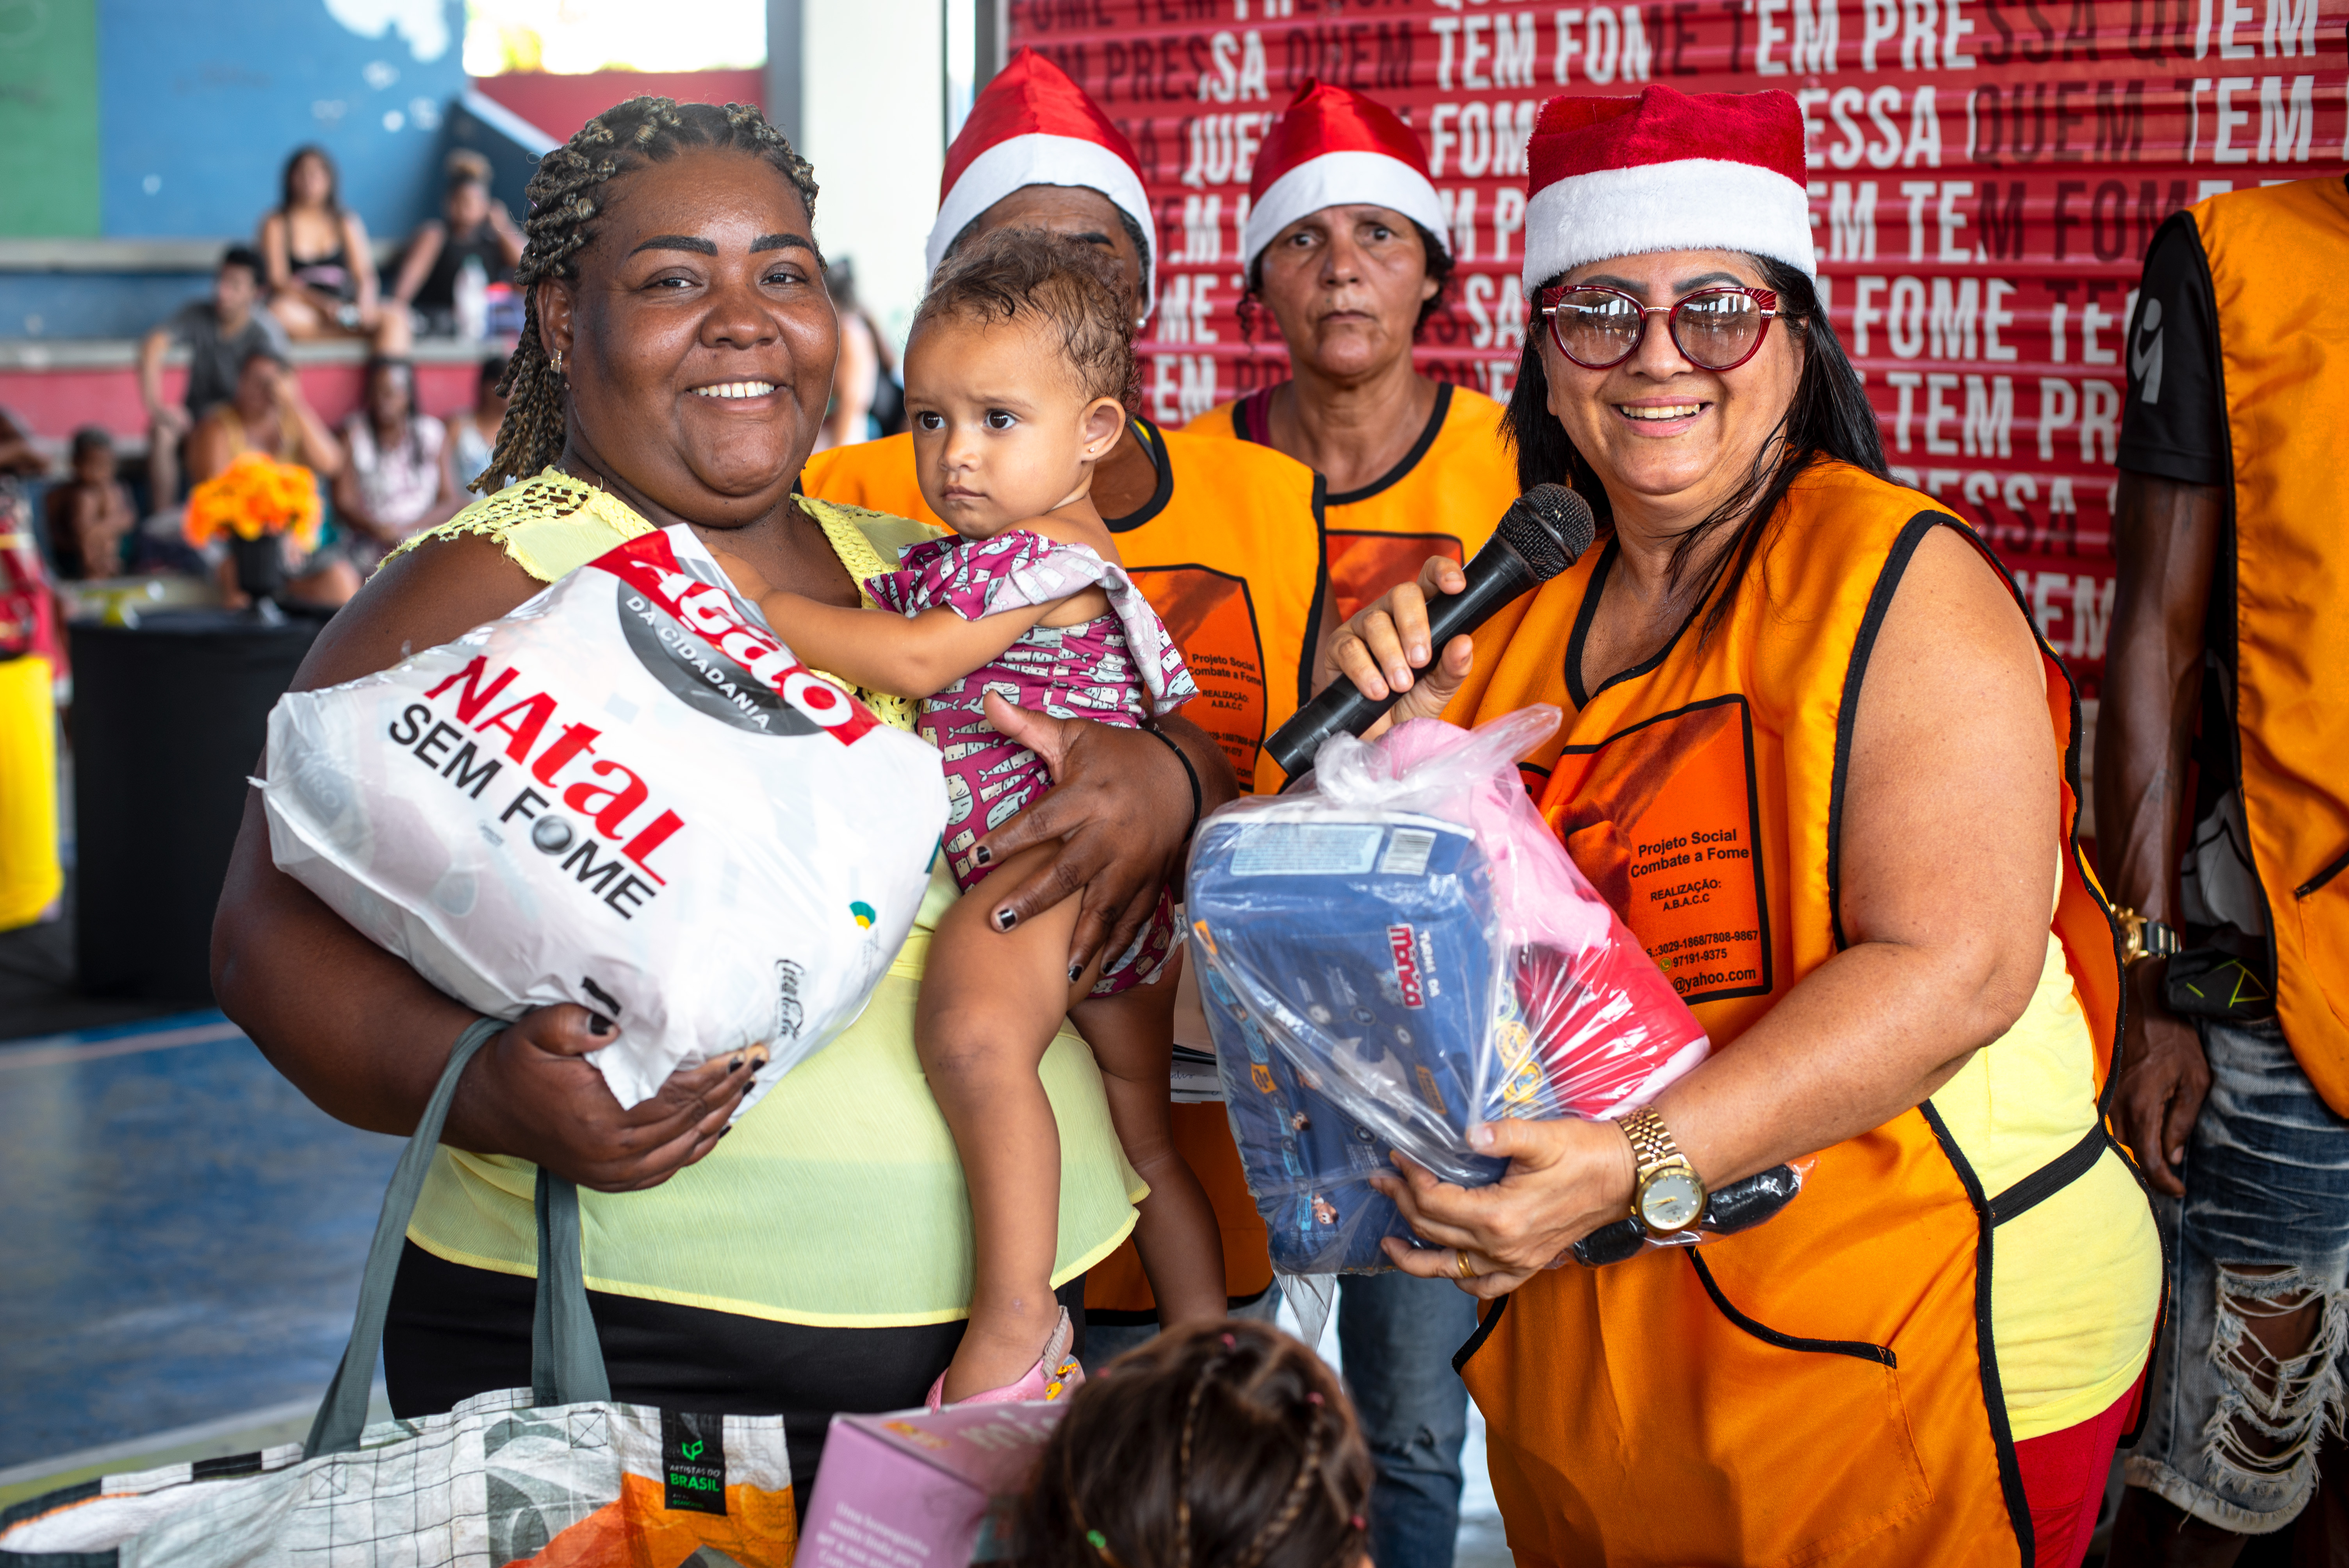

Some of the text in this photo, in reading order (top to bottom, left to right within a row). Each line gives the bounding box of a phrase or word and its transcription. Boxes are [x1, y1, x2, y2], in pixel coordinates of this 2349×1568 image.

[1430, 11, 1537, 91] TEM
[1554, 4, 1698, 86] FOME
[1723, 0, 1840, 74] TEM
[1861, 0, 2101, 73] PRESSA
[2128, 0, 2319, 67] QUEM
[1798, 85, 1943, 169] ESSA
[1966, 78, 2144, 170] QUEM
[2173, 75, 2315, 165] TEM
[1900, 180, 2026, 263] TEM
[1852, 275, 2019, 362] FOME
[1886, 372, 2015, 458] TEM
[626, 595, 773, 731] DA CIDADANIA
[1187, 665, 1262, 687] Combate a Fome
[1192, 653, 1256, 672] Projeto Social
[388, 703, 657, 921] SEM FOME
[1638, 828, 1738, 858] Projeto Social
[1630, 846, 1750, 878] Combate a Fome
[1650, 878, 1723, 902] REALIZAÇÃO:
[1662, 893, 1710, 912] A.B.A.C.C
[1673, 948, 1728, 968] 97191-9375
[1427, 977, 1442, 998] DA
[1672, 968, 1757, 995] @yahoo.com
[669, 1464, 721, 1478] ARTISTAS DO
[669, 1472, 721, 1493] BRASIL
